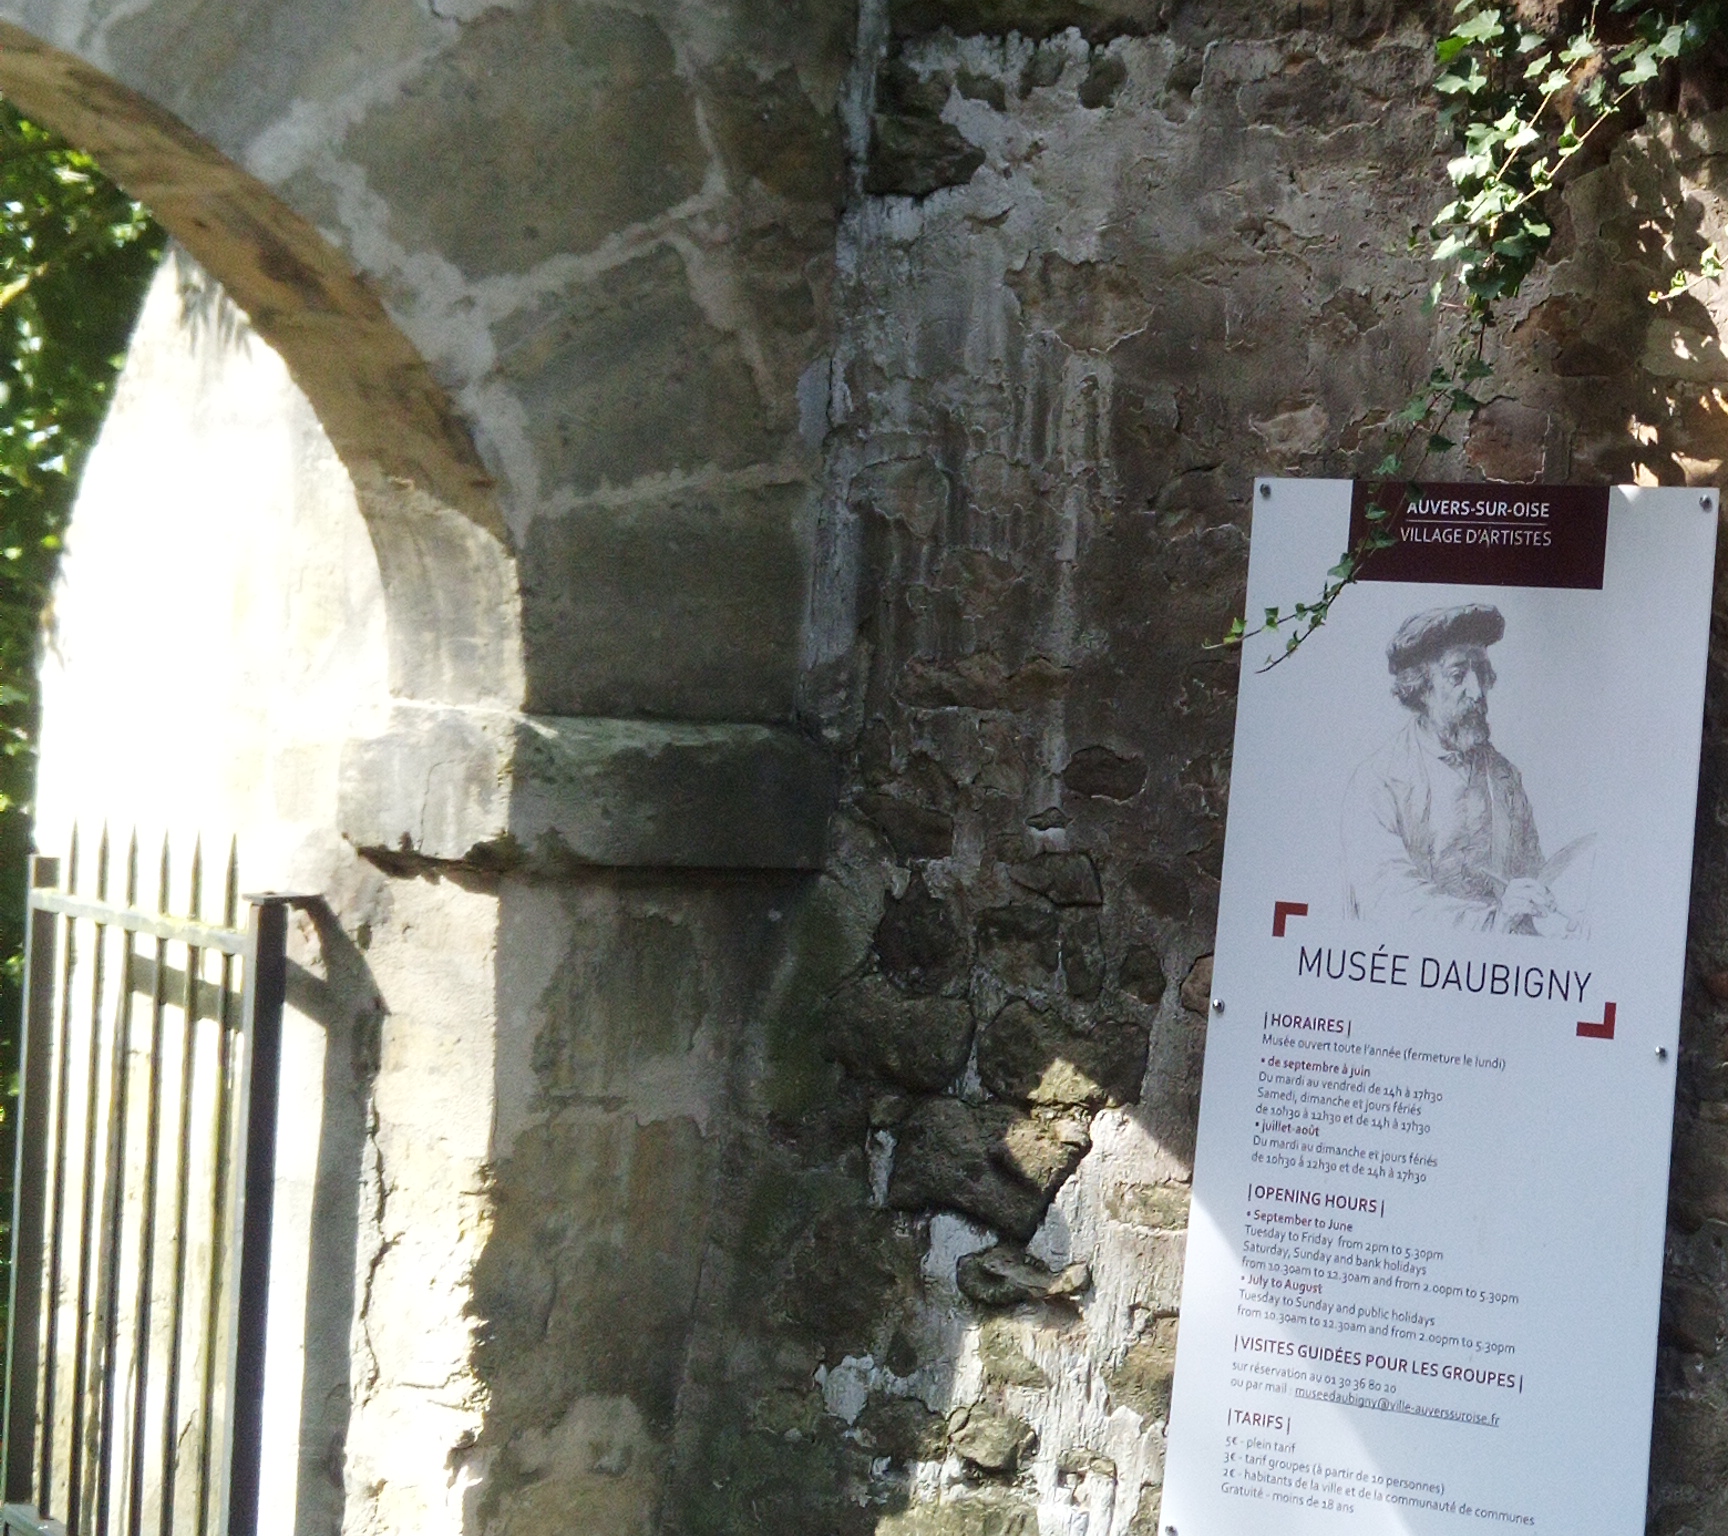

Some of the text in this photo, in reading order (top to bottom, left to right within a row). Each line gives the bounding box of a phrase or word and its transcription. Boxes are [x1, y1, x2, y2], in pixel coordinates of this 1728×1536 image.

[1407, 499, 1550, 518] AUVERS-SUR-OISE
[1400, 527, 1552, 546] VILLAGE D'ARTISTES
[1298, 944, 1592, 1003] MUSÉE DAUBIGNY
[1270, 1013, 1344, 1034] HORAIRES
[1261, 1033, 1506, 1072] Musée ouvert toute l'année (fermeture le lundi)
[1267, 1055, 1371, 1079] de septembre à juin
[1257, 1085, 1422, 1116] Samedi, dimanche et jours fériés
[1258, 1070, 1443, 1104] Du mardi au vendredi de 14h à 17h30
[1255, 1102, 1431, 1136] de 10h30 à 12h30 et de 14h à 17h30
[1250, 1150, 1427, 1185] de 10h30 à 12h30 et de 14h à 17h30
[1252, 1134, 1438, 1168] Du mardi au dimanche et jours fériés
[1254, 1184, 1377, 1213] OPENING HOURS
[1253, 1208, 1353, 1232] September to June
[1244, 1223, 1403, 1255] Tuesday to Friday from 2pm to
[1242, 1239, 1427, 1277] Saturday, Sunday and bank holidays
[1241, 1255, 1266, 1270] from
[1313, 1267, 1325, 1278] to
[1326, 1270, 1371, 1284] 12.30am
[1372, 1274, 1393, 1287] and
[1394, 1275, 1421, 1291] from
[1465, 1287, 1478, 1299] to
[1247, 1273, 1323, 1295] July to August
[1238, 1288, 1435, 1328] Tuesday to Sunday and public holidays
[1237, 1303, 1262, 1318] from
[1309, 1315, 1321, 1327] to
[1322, 1318, 1367, 1333] 12.30am
[1368, 1323, 1389, 1336] and
[1390, 1324, 1417, 1340] from
[1461, 1336, 1473, 1349] to
[1232, 1361, 1397, 1394] sur réservation au 01 30 36 80 20
[1240, 1335, 1515, 1388] VISITES GUIDÉES POUR LES GROUPES
[1230, 1377, 1244, 1388] ou
[1245, 1380, 1263, 1392] par
[1264, 1382, 1287, 1393] mail
[1233, 1409, 1283, 1430] TARIFS
[1225, 1435, 1296, 1453] 5€ plein tarif
[1223, 1451, 1445, 1497] 3€ tarif groupes (à partir de 10 personnes)
[1220, 1481, 1354, 1514] Gratuité moins de 18 ans
[1222, 1467, 1535, 1526] 2€ habitants de la ville et de la communauté de communes
